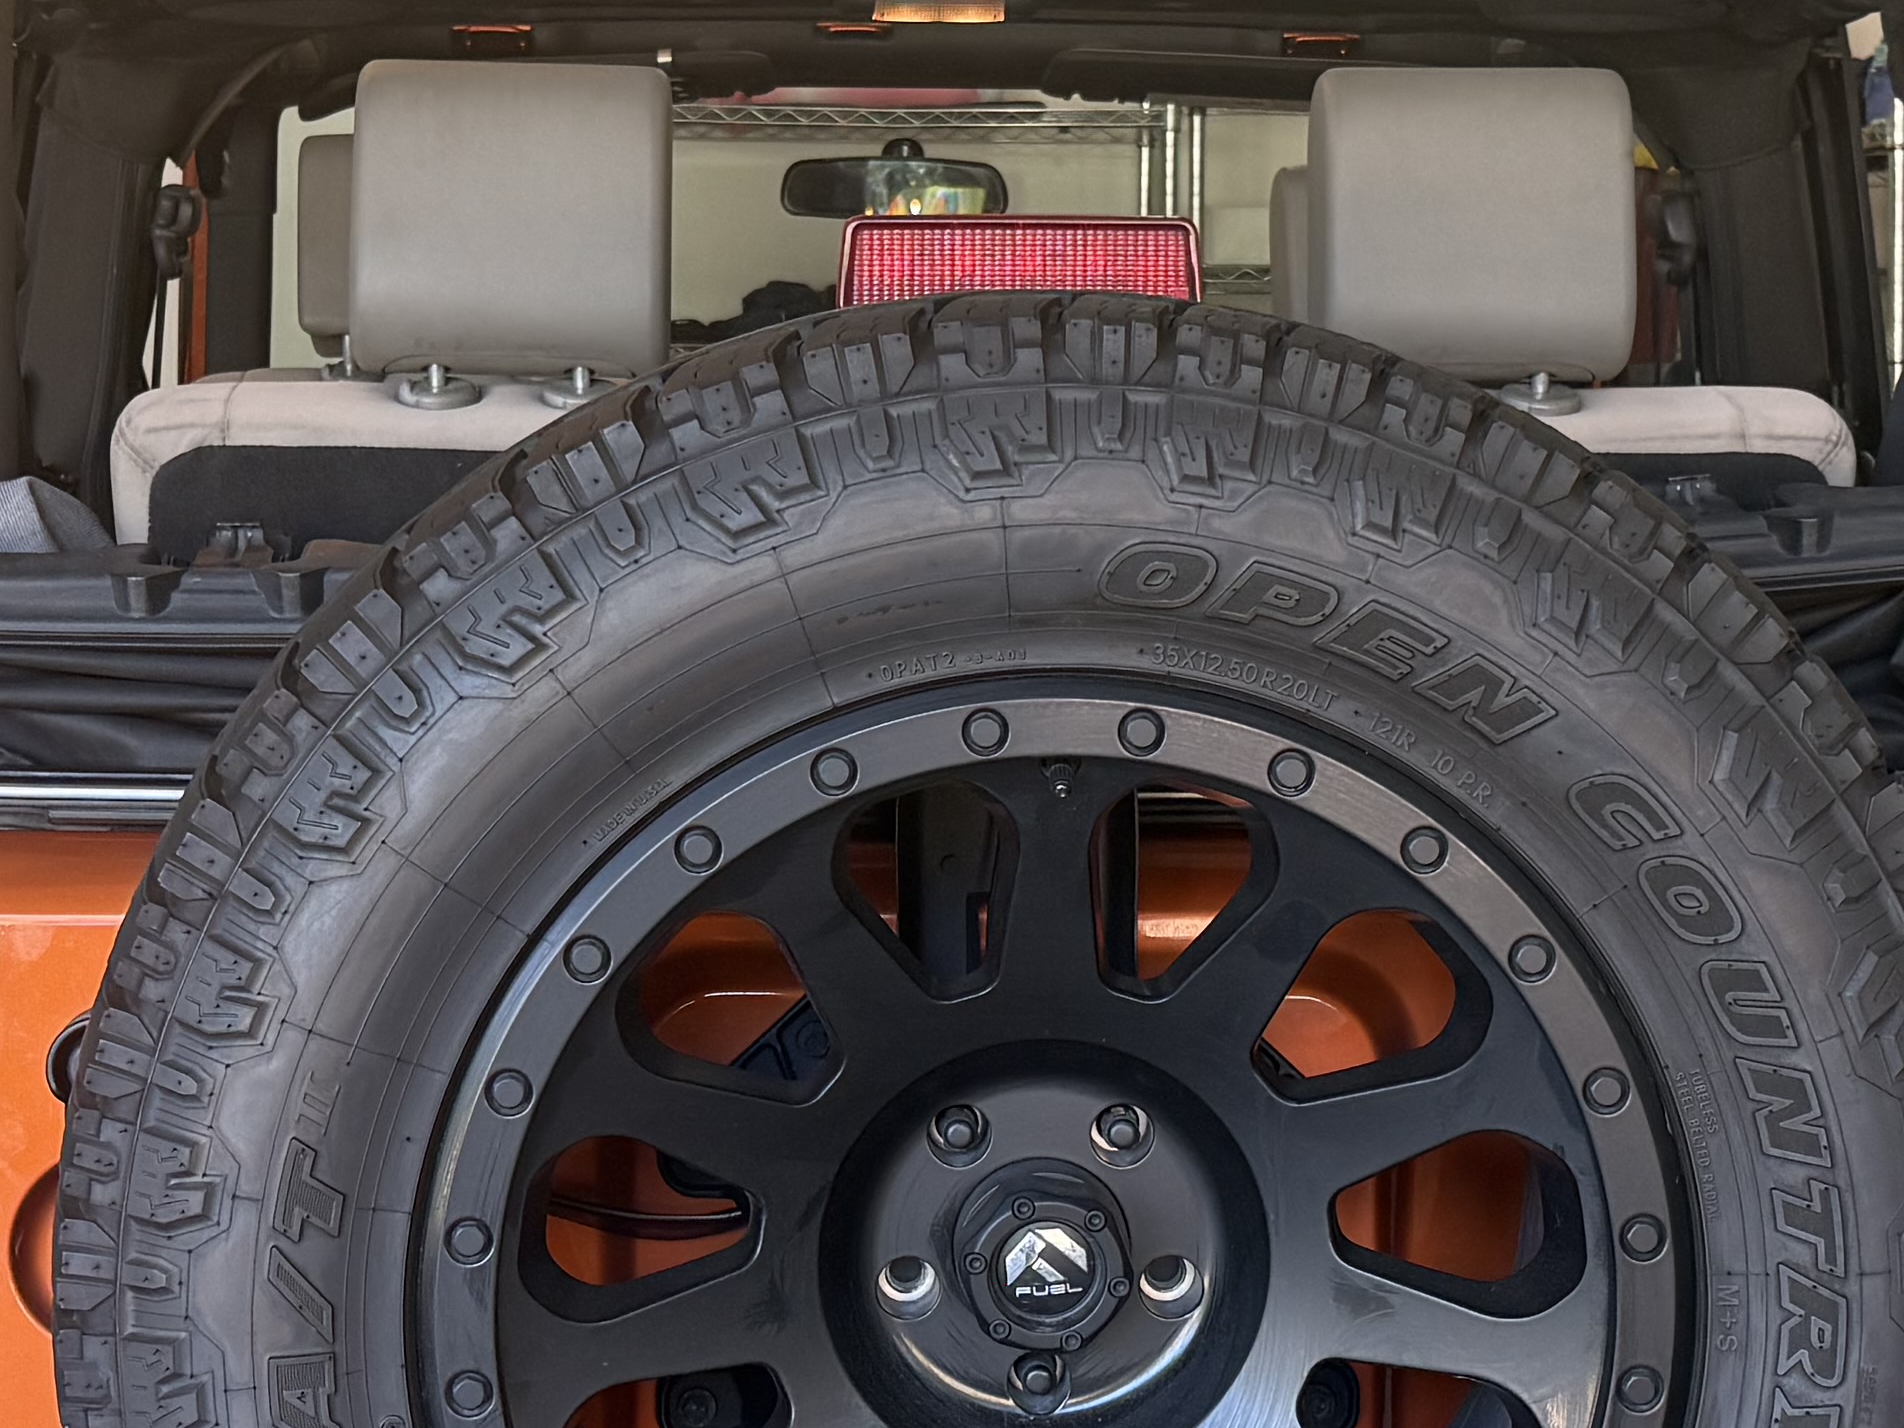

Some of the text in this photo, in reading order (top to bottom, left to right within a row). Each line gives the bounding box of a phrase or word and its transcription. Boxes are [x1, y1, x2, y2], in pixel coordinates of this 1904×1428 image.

[1097, 540, 1560, 745] OPEN
[1430, 749, 1455, 778] 10
[1692, 1069, 1719, 1134] TUBELESS
[1674, 1071, 1723, 1220] STEEL BELTED RADIAL
[1015, 1283, 1084, 1299] FUEL
[1716, 1283, 1742, 1353] M+S
